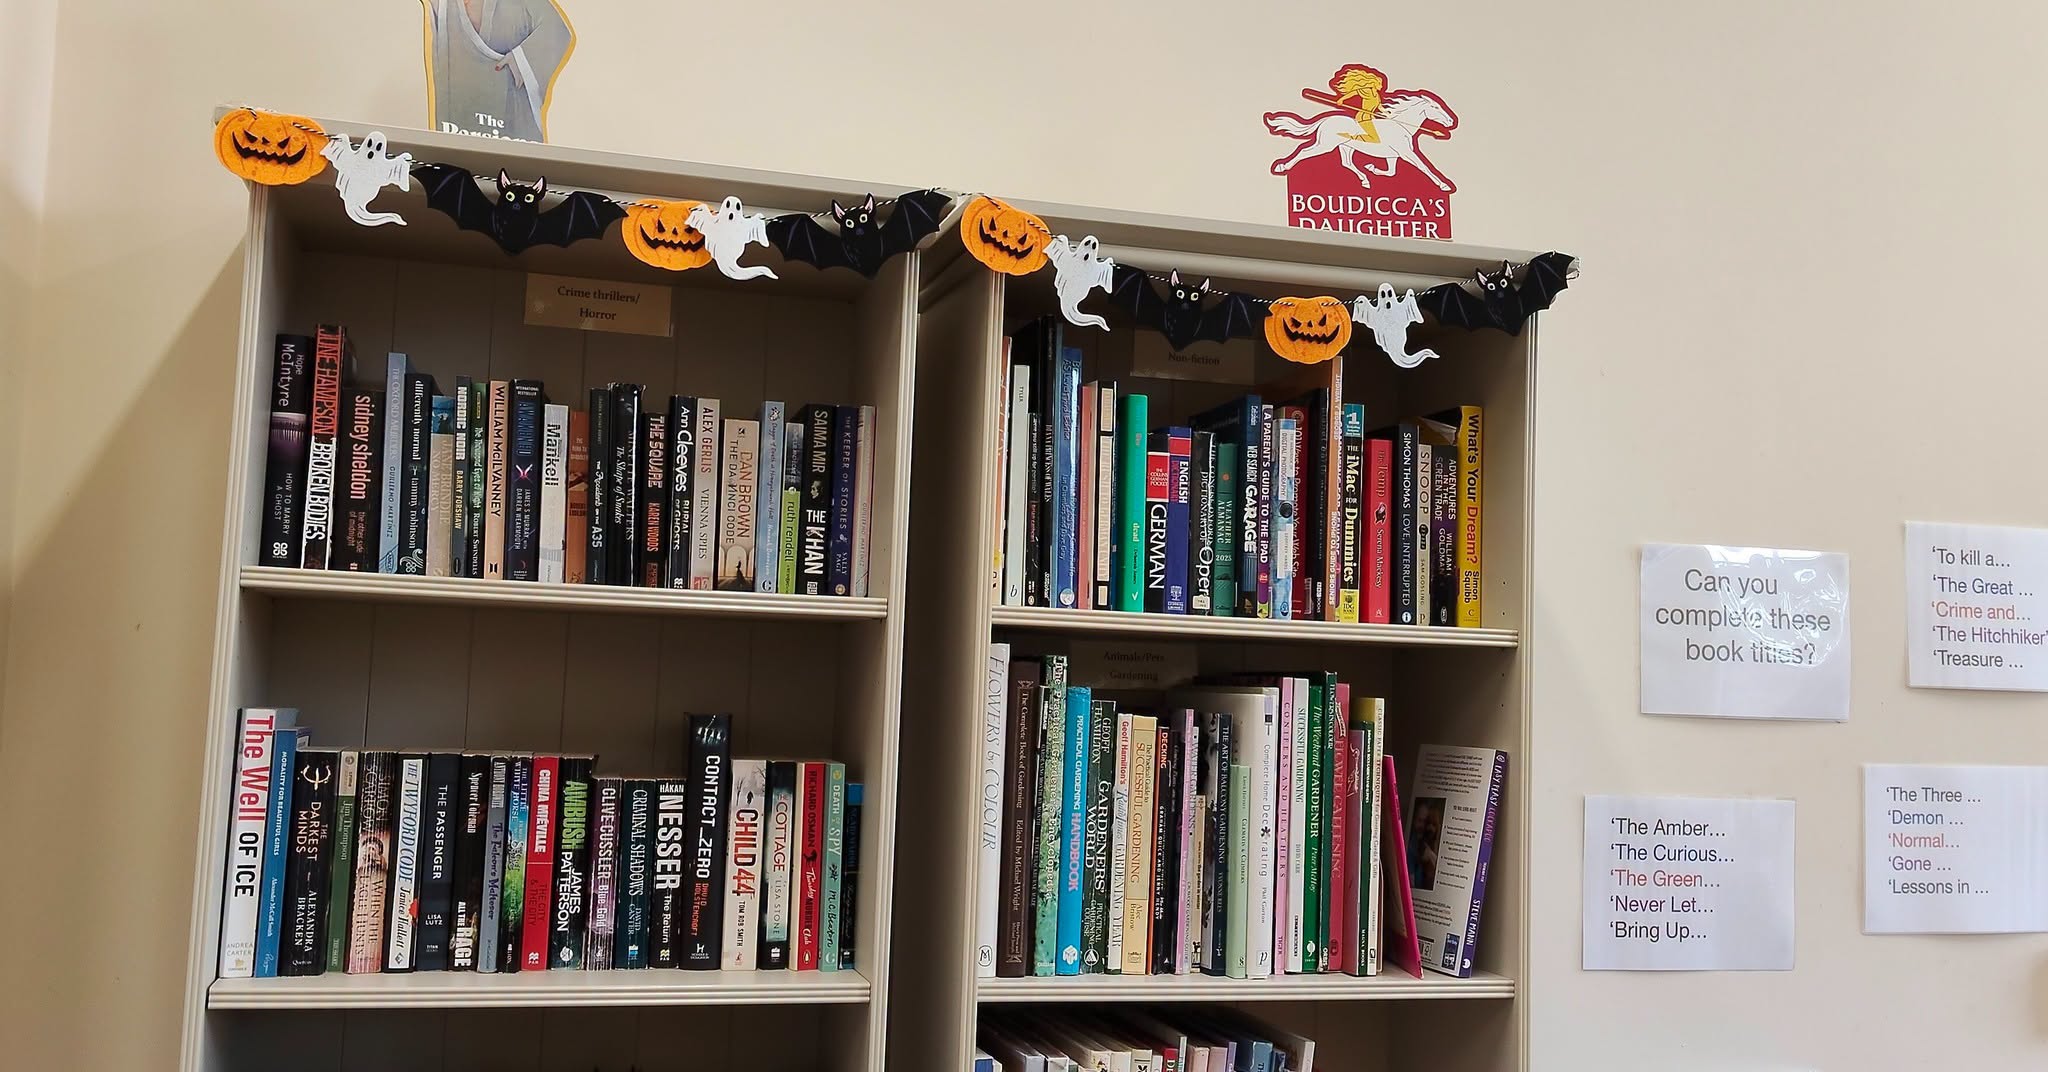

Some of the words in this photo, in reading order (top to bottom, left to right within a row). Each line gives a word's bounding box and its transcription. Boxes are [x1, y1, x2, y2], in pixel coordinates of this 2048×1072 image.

[475, 112, 504, 128] The
[1291, 193, 1446, 218] BOUDICCA'S
[557, 286, 590, 298] Crime
[593, 289, 641, 304] thrillers/
[580, 308, 616, 320] Horror
[278, 343, 296, 408] McIntyre
[296, 354, 304, 376] Hope
[1168, 351, 1220, 366] Non-fiction
[353, 395, 376, 441] sidney
[456, 386, 468, 430] NORDIC
[493, 385, 506, 440] WILLIAM
[680, 406, 690, 430] Ann
[702, 407, 714, 432] ALEX
[1264, 412, 1272, 420] A
[456, 432, 466, 460] NOIR
[650, 416, 665, 440] THE
[814, 410, 828, 449] SAIMA
[1262, 422, 1272, 468] PARENT'S
[1468, 414, 1480, 464] What's
[648, 441, 664, 488] SQUARE
[675, 430, 694, 492] Cleeves
[700, 437, 712, 474] GERLIS
[730, 440, 738, 460] THE
[738, 451, 753, 480] DAN
[812, 450, 826, 478] MIR
[1402, 432, 1411, 467] SIMON
[310, 444, 333, 494] BROKEN
[350, 442, 372, 500] sheldon
[490, 441, 504, 517] McILVANNEY
[728, 462, 737, 478] DA
[1178, 460, 1188, 504] ENGLISH
[1262, 470, 1270, 500] GUIDE
[1346, 455, 1360, 492] iMac
[1419, 453, 1430, 514] SNOOP
[1467, 468, 1480, 502] Your
[726, 480, 736, 514] VINCI
[1402, 468, 1410, 508] THOMAS
[1448, 459, 1456, 520] ADVENTURES
[306, 495, 329, 540] BODIES
[648, 502, 660, 526] KAREN
[700, 488, 710, 530] VIENNA
[736, 485, 752, 538] BROWN
[786, 502, 794, 523] ruth
[806, 510, 826, 524] THE
[1216, 500, 1224, 544] ALMANAC
[1224, 500, 1232, 544] WEATHER
[1244, 484, 1258, 554] GARAGE
[1260, 518, 1268, 536] THE
[1261, 502, 1268, 516] TO
[1402, 514, 1410, 540] LOVE,
[592, 526, 602, 548] A35
[647, 528, 658, 552] WOODS
[699, 533, 708, 559] SPIES
[726, 516, 736, 544] CODE
[785, 526, 794, 562] rendell
[1148, 504, 1168, 589] GERMAN
[1343, 508, 1358, 582] Dummies
[1464, 506, 1479, 564] Dream?
[804, 526, 824, 575] KHAN
[1260, 538, 1268, 564] iPAD
[1438, 528, 1446, 577] GOLDMAN
[1932, 546, 1955, 564] ‘To
[1960, 550, 1980, 566] kill
[1986, 554, 2010, 568] a...
[1402, 542, 1410, 605] INTERRUPTED
[1463, 570, 1473, 604] Squibb
[1684, 569, 1730, 592] Can
[1738, 577, 1778, 599] you
[1932, 574, 1967, 592] ‘The
[1972, 578, 2014, 596] Great
[1655, 606, 1762, 631] complete
[1771, 608, 1830, 631] these
[1932, 601, 1982, 619] ‘Crime
[1987, 605, 2030, 620] and...
[1686, 638, 1743, 662] book
[1932, 626, 1966, 642] ‘The
[1110, 671, 1158, 682] Gardening
[1933, 650, 2003, 668] ‘Treasure
[984, 656, 1005, 745] FLOWERS
[1314, 704, 1322, 720] The
[242, 715, 274, 758] The
[1075, 715, 1083, 761] PRACTICAL
[1092, 706, 1102, 764] HAMILTON
[1102, 716, 1110, 754] GEOFF
[1159, 732, 1167, 770] DECKING
[1312, 722, 1322, 763] Weekend
[987, 749, 998, 765] by
[1120, 744, 1128, 785] Hamilton's
[238, 765, 270, 822] Well
[538, 769, 551, 803] CHINA
[660, 782, 684, 793] HÅKAN
[1073, 762, 1082, 810] GARDENING
[1134, 742, 1145, 810] SUCCESSFUL
[1886, 786, 1918, 802] ‘The
[1922, 787, 1962, 802] Three
[437, 785, 448, 807] THE
[600, 788, 616, 822] CLIVE
[982, 768, 1000, 850] COLOUR
[1310, 764, 1319, 838] GARDENER
[296, 810, 308, 854] MINDS
[310, 801, 322, 862] DARKEST
[534, 804, 548, 854] MIÉVILLE
[561, 781, 588, 850] AMBUSH
[631, 789, 648, 842] CRIMINAL
[696, 755, 721, 880] CONTACT_ZERO
[1611, 818, 1648, 834] ‘The
[1653, 818, 1726, 836] Amber...
[1888, 810, 1944, 824] ‘Demon
[238, 832, 260, 858] OF
[432, 810, 446, 880] PASSENGER
[598, 824, 614, 880] CUSSLER
[656, 794, 684, 890] NESSER
[736, 808, 760, 868] CHILD
[773, 801, 788, 874] COTTAGE
[1068, 812, 1081, 892] HANDBOOK
[1085, 804, 1098, 868] WORLD
[1094, 780, 1110, 892] GARDENERS'
[1130, 813, 1142, 883] GARDENING
[1610, 844, 1648, 860] ‘The
[1653, 844, 1734, 862] Curious...
[1888, 833, 1960, 848] ‘Normal...
[234, 864, 256, 898] ICE
[628, 845, 646, 896] SHADOWS
[1610, 870, 1647, 886] ‘The
[1652, 870, 1720, 887] Green...
[1888, 856, 1932, 871] ‘Gone
[556, 852, 572, 932] PATTERSON
[570, 868, 583, 915] JAMES
[597, 884, 609, 906] Blue
[732, 867, 756, 900] 44
[1888, 879, 1954, 894] ‘Lessons
[1958, 879, 1970, 894] in
[295, 896, 306, 946] BRACKEN
[304, 890, 316, 952] ALEXANDRA
[458, 901, 466, 912] ALL
[596, 906, 608, 928] Gold
[664, 894, 672, 912] The
[1610, 895, 1666, 912] ‘Never
[1671, 896, 1713, 912] Let...
[662, 912, 672, 944] Return
[1610, 922, 1660, 942] ‘Bring
[1666, 922, 1706, 942] Up...
[454, 926, 474, 968] RAGE
